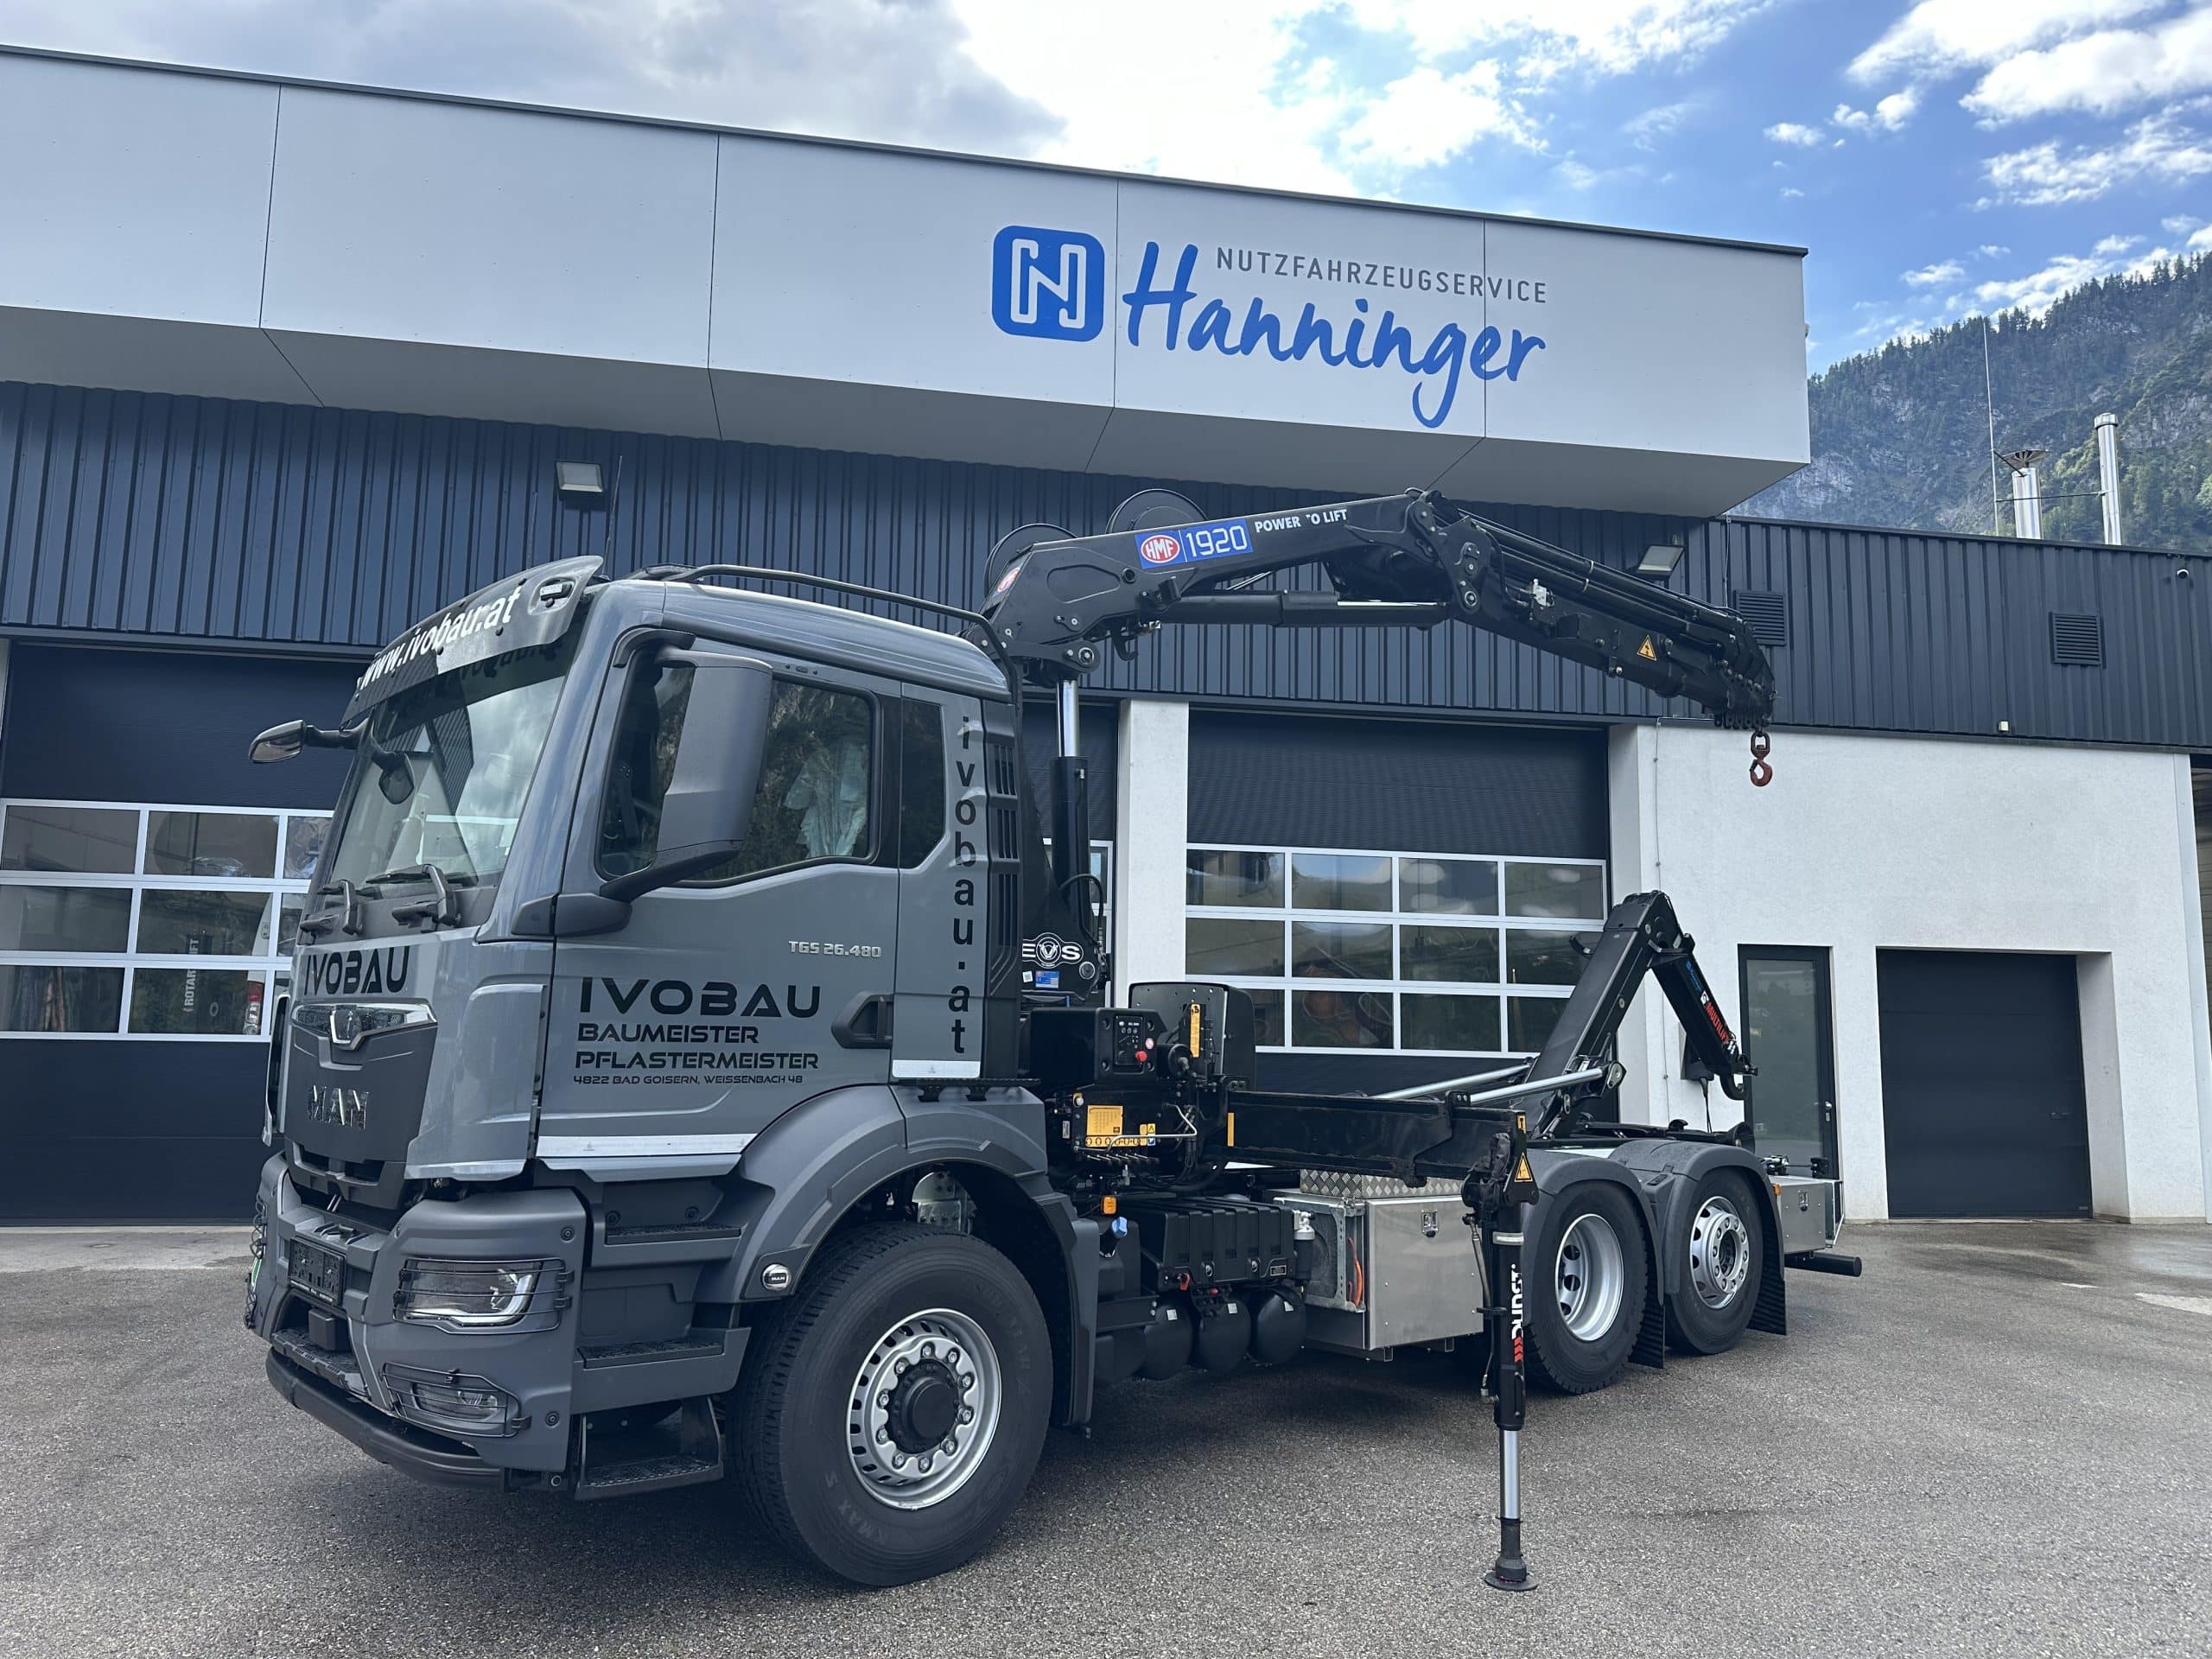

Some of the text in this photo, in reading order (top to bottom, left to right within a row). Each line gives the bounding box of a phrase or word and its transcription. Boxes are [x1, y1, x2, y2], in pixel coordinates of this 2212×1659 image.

[1217, 246, 1547, 303] NUTZFAHRZEUGSERVICE
[1122, 241, 1546, 429] Hanninger
[1254, 516, 1302, 533] POWER
[1322, 509, 1348, 524] LIFT
[1144, 538, 1174, 560] HMF
[1185, 524, 1248, 557] 1920
[356, 585, 523, 690] www.ivobau.at
[788, 940, 882, 958] TGS 26.480
[303, 945, 410, 995] IVOBAU
[579, 976, 821, 1018] IVOBAU
[577, 1022, 759, 1044] BAUMEISTER
[575, 1051, 819, 1069] PFLASTERMEISTER
[573, 1075, 803, 1085] 4822 BAD GOISERN, WEISSENBACH 48
[308, 1084, 370, 1130] MAN
